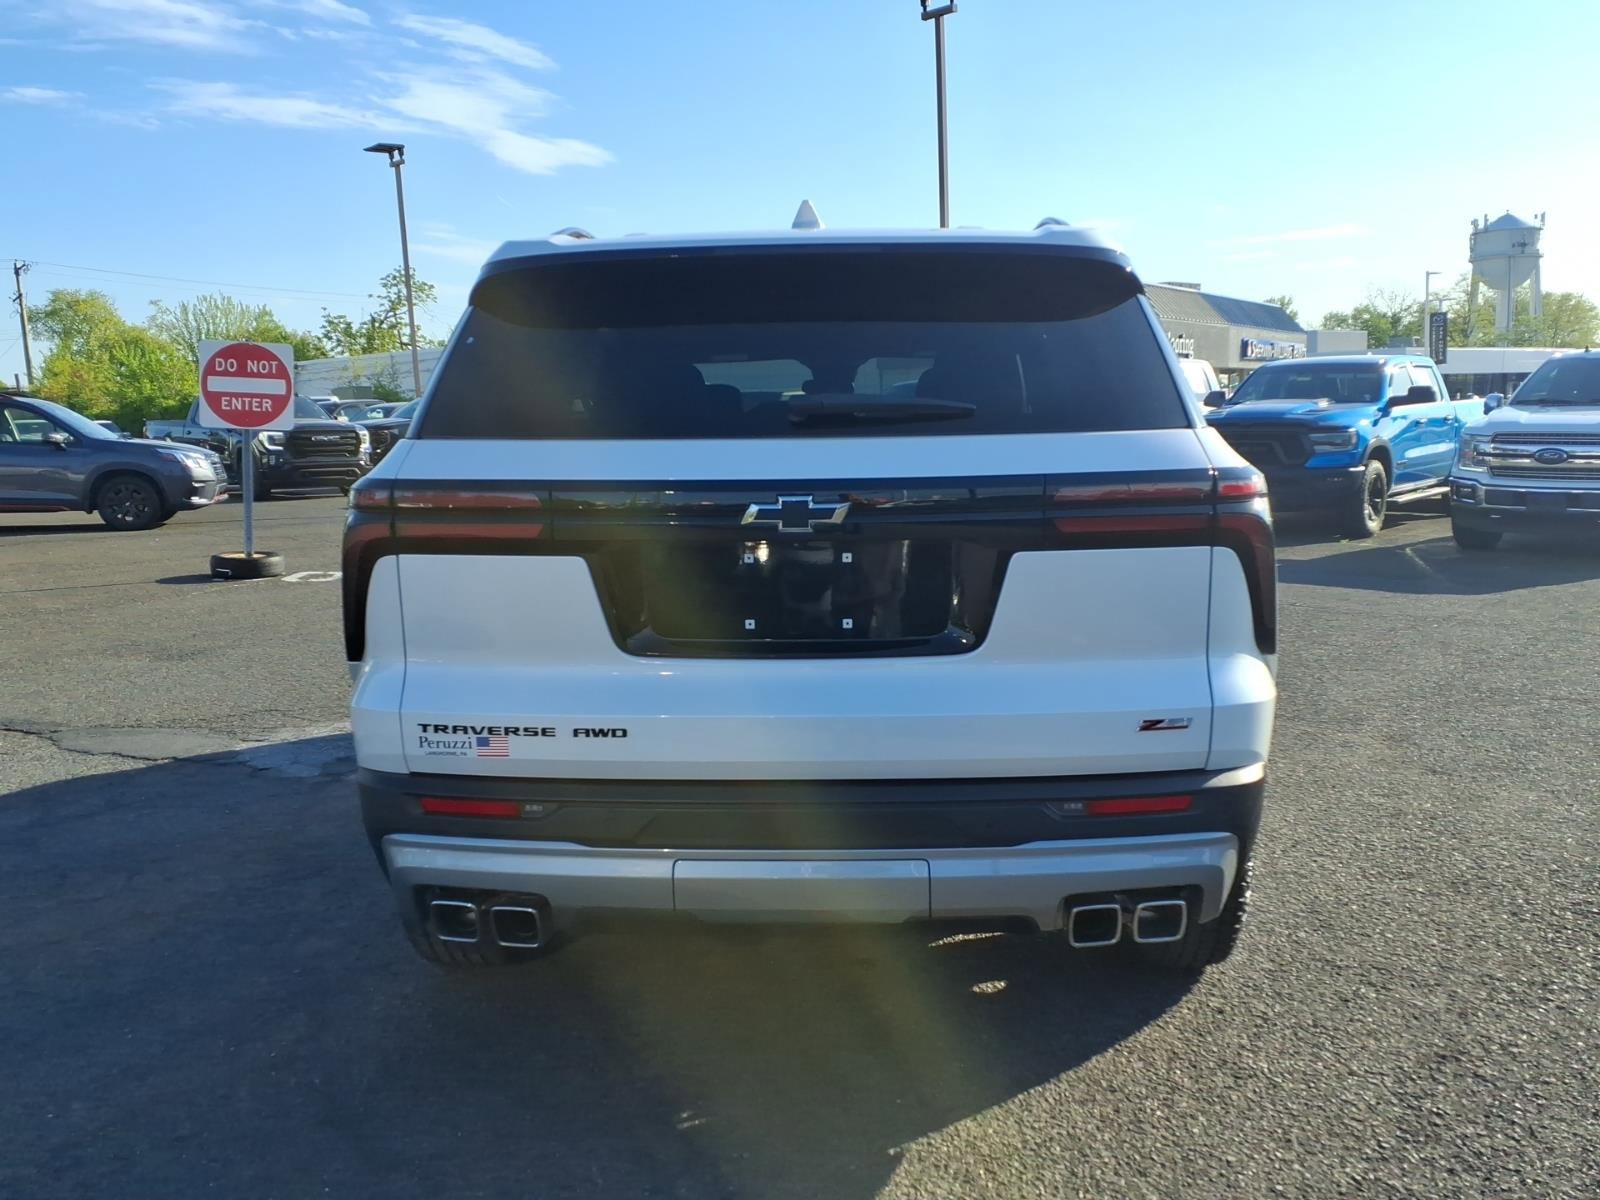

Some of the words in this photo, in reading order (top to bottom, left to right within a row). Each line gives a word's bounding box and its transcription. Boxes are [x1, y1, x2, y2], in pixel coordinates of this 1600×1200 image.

[215, 358, 237, 372] DO
[247, 359, 279, 374] NOT
[221, 397, 272, 412] ENTER
[417, 723, 556, 737] TRAVERSE
[573, 728, 628, 738] AWD
[418, 735, 473, 749] Peruzzi
